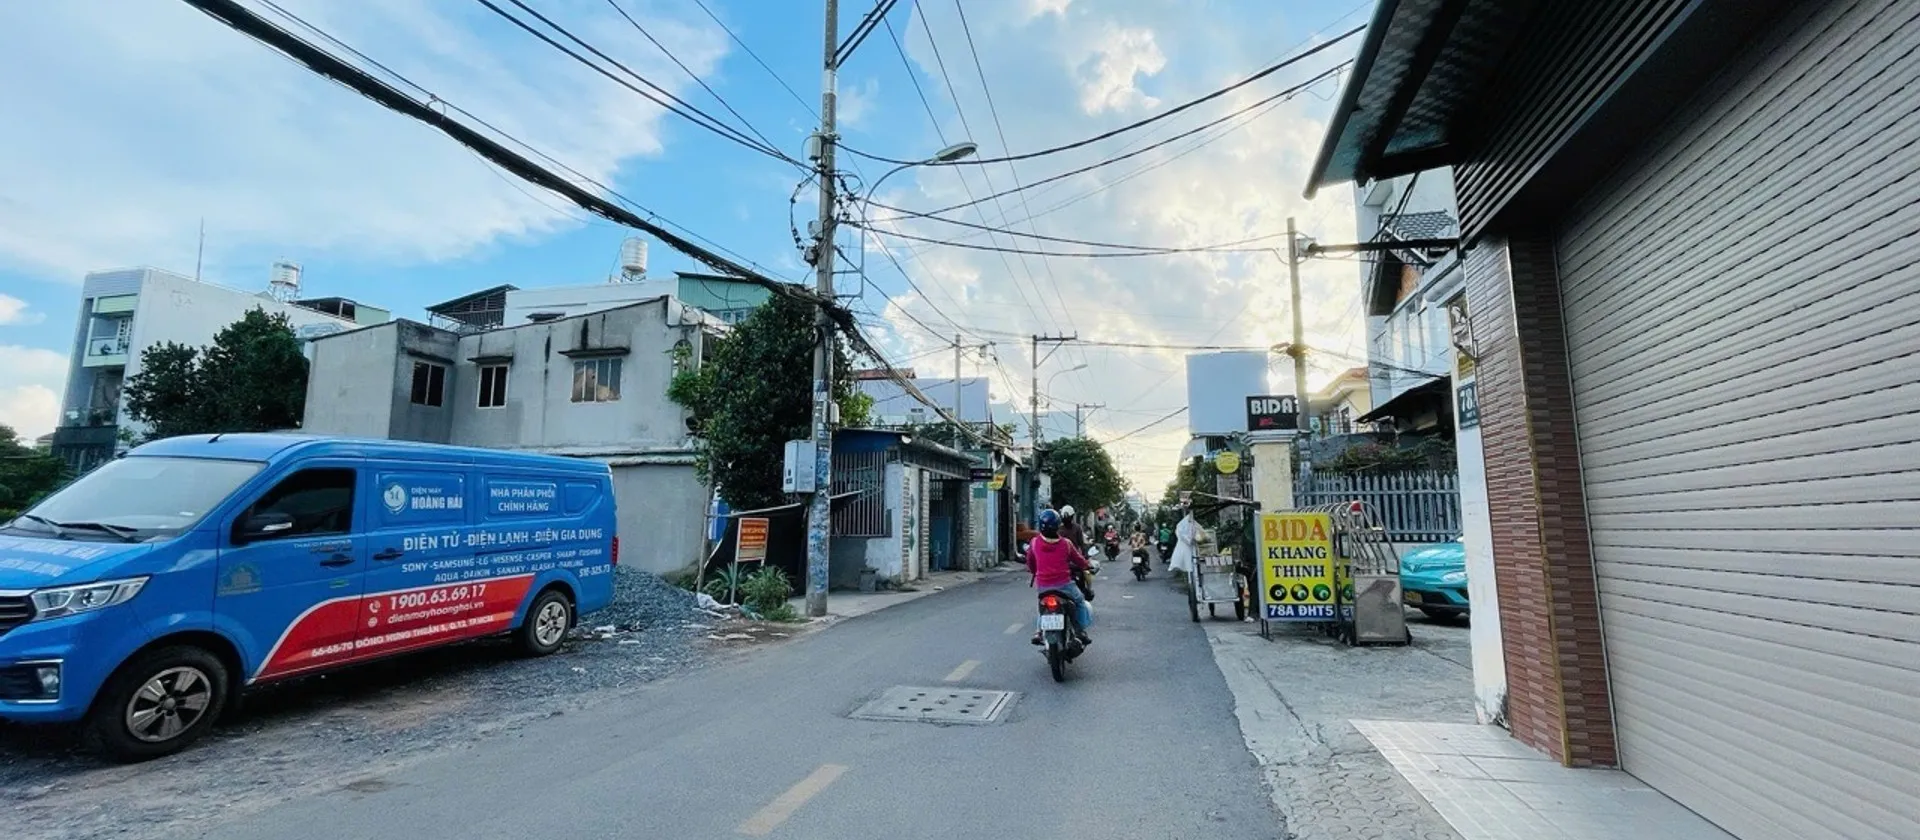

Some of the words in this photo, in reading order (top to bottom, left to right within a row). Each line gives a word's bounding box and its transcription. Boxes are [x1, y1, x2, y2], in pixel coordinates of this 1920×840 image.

[1251, 398, 1293, 415] BIDA
[512, 487, 535, 498] PHÂN
[536, 487, 556, 498] PHỐI
[411, 495, 445, 510] HOÀNG
[498, 501, 525, 511] CHÍNH
[1264, 518, 1328, 541] BIDA
[403, 533, 438, 554] ĐIỆN
[441, 530, 460, 548] TỬ
[499, 531, 529, 547] LẠNH
[561, 529, 578, 541] GIA
[1268, 546, 1327, 559] KHANG
[401, 562, 428, 573] SONY
[1272, 565, 1325, 581] THỊNH
[434, 573, 458, 582] AQUA
[390, 584, 486, 610] 1900.63.69.17
[387, 601, 485, 624] dienmayhoanghai.vn
[1269, 605, 1295, 617] 78A
[1298, 604, 1334, 617] ĐHT5
